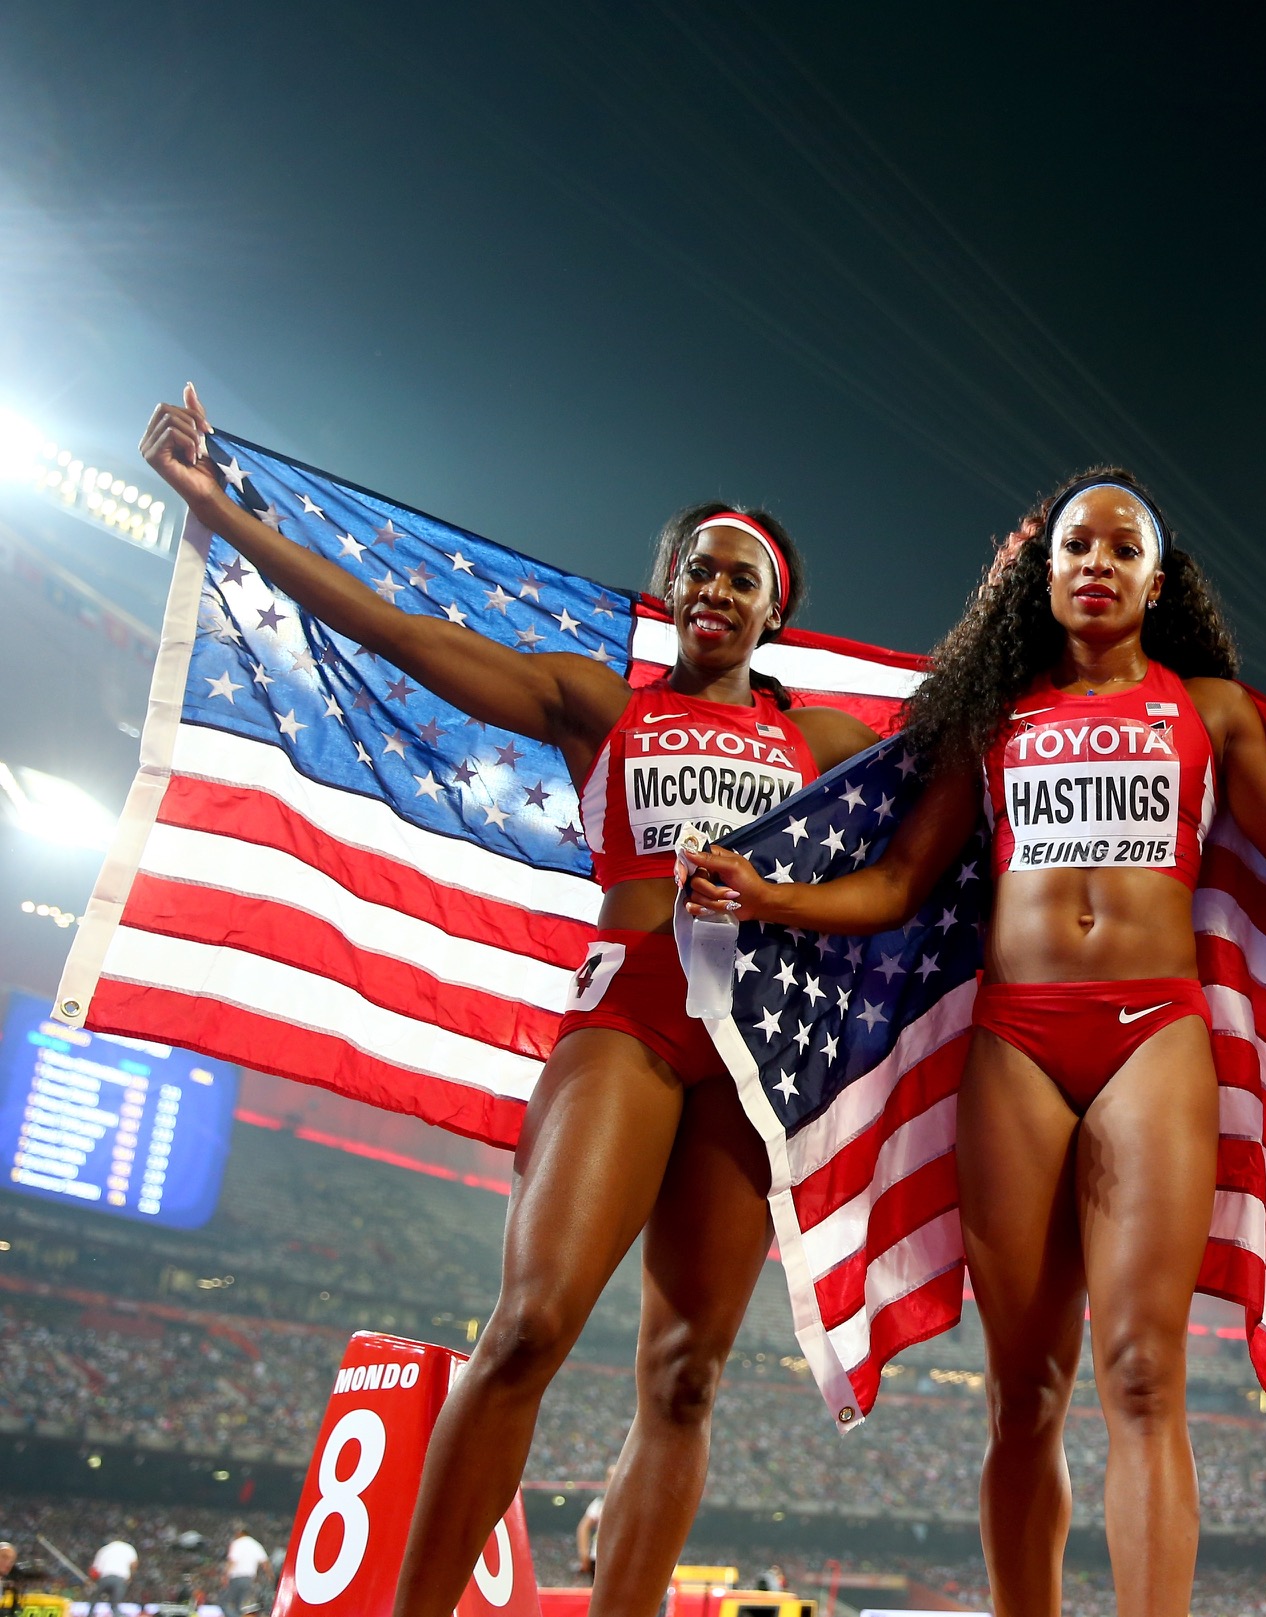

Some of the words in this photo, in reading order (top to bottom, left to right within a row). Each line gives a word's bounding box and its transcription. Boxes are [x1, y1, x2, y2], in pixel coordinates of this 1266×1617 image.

[633, 727, 795, 769] TOYOTA
[1015, 725, 1173, 760] TOYOTA
[633, 765, 796, 816] McCORORY
[1012, 775, 1170, 827] HASTINGS
[1019, 840, 1109, 866] BEIJING
[1113, 840, 1169, 863] 2015
[576, 952, 603, 999] 4
[333, 1362, 420, 1395] MONDO
[295, 1408, 387, 1606] 8
